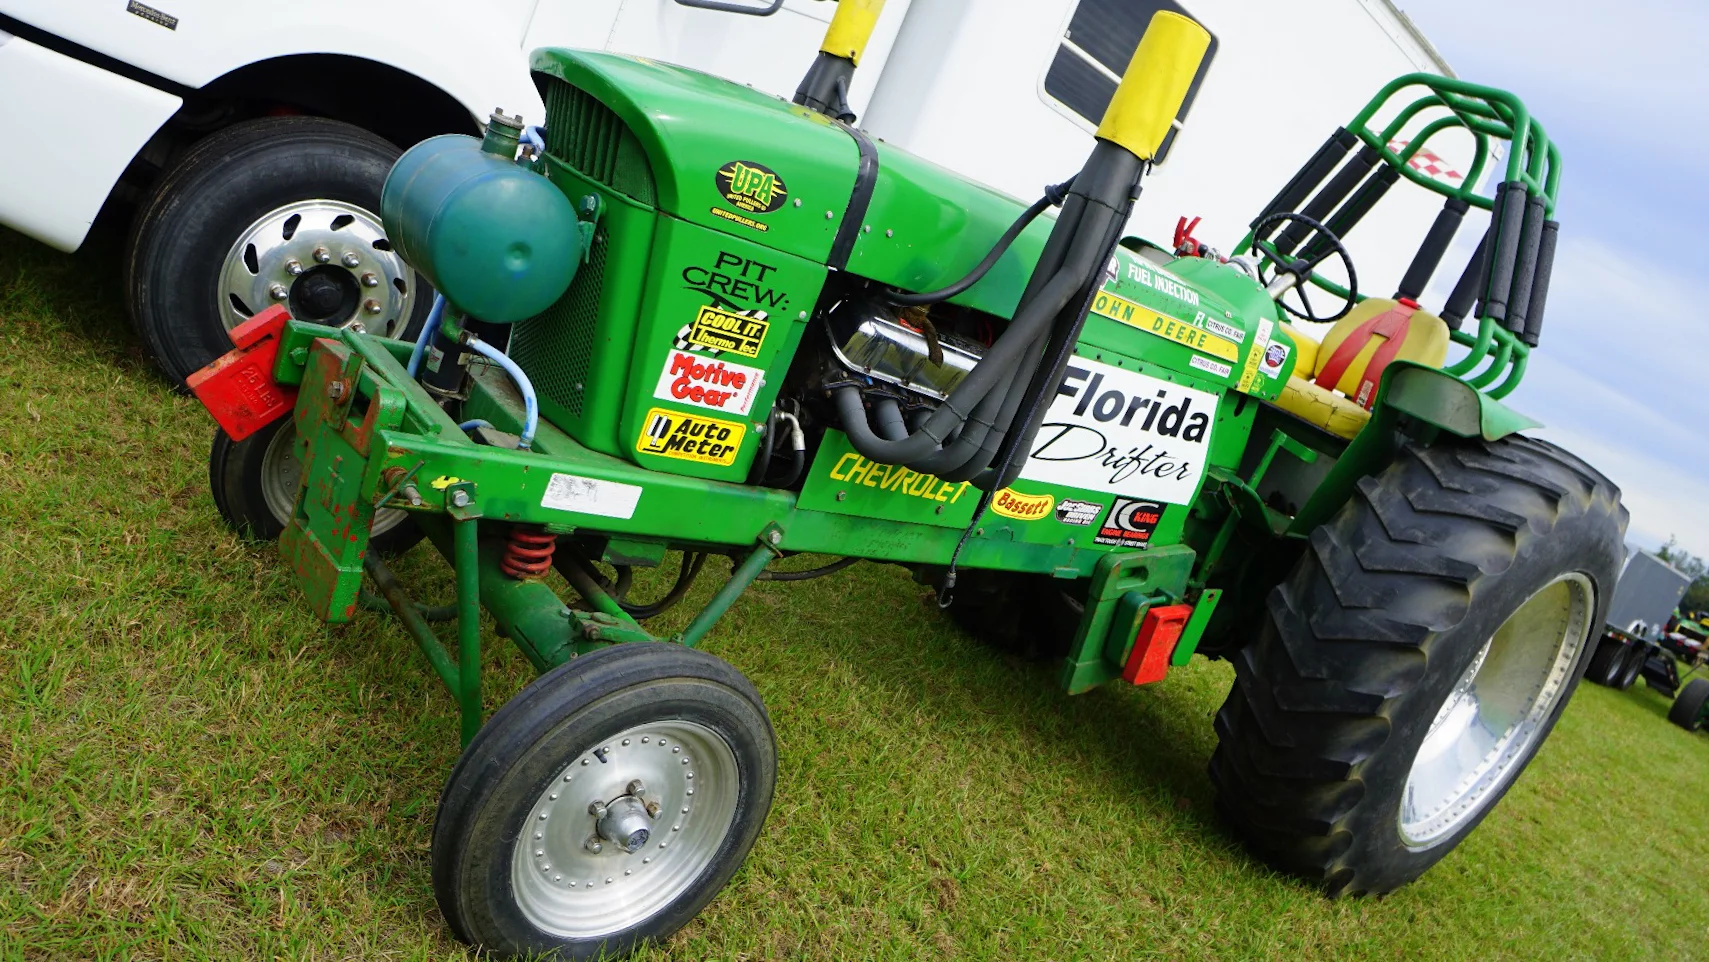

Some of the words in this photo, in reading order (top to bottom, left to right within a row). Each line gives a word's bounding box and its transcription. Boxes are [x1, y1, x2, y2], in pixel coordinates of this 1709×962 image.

[731, 162, 775, 206] UPA
[711, 207, 768, 231] UNITEDPULLERS.ORG
[713, 251, 777, 282] PIT
[682, 266, 790, 311] CREW:
[1127, 262, 1153, 287] FUEL
[1154, 274, 1199, 306] INJECTION
[700, 311, 742, 334] COOL
[1095, 295, 1135, 322] OHN
[1152, 316, 1208, 347] DEERE
[1192, 310, 1206, 329] FL
[1207, 320, 1226, 333] CITRUS
[1233, 331, 1244, 340] FAIR
[695, 325, 736, 349] Thermo
[738, 337, 760, 354] Tec
[670, 352, 747, 390] Motive
[1191, 356, 1210, 369] CITRUS
[1218, 365, 1230, 375] FAIR
[671, 377, 732, 408] Gear
[1049, 365, 1210, 444] Florida
[675, 418, 732, 442] Auto
[664, 434, 735, 459] Meter
[1030, 422, 1193, 485] Drifter
[829, 452, 972, 504] CHEVROLET
[997, 492, 1049, 516] Bassett
[1133, 511, 1160, 525] KING
[1101, 528, 1122, 537] ENGINE
